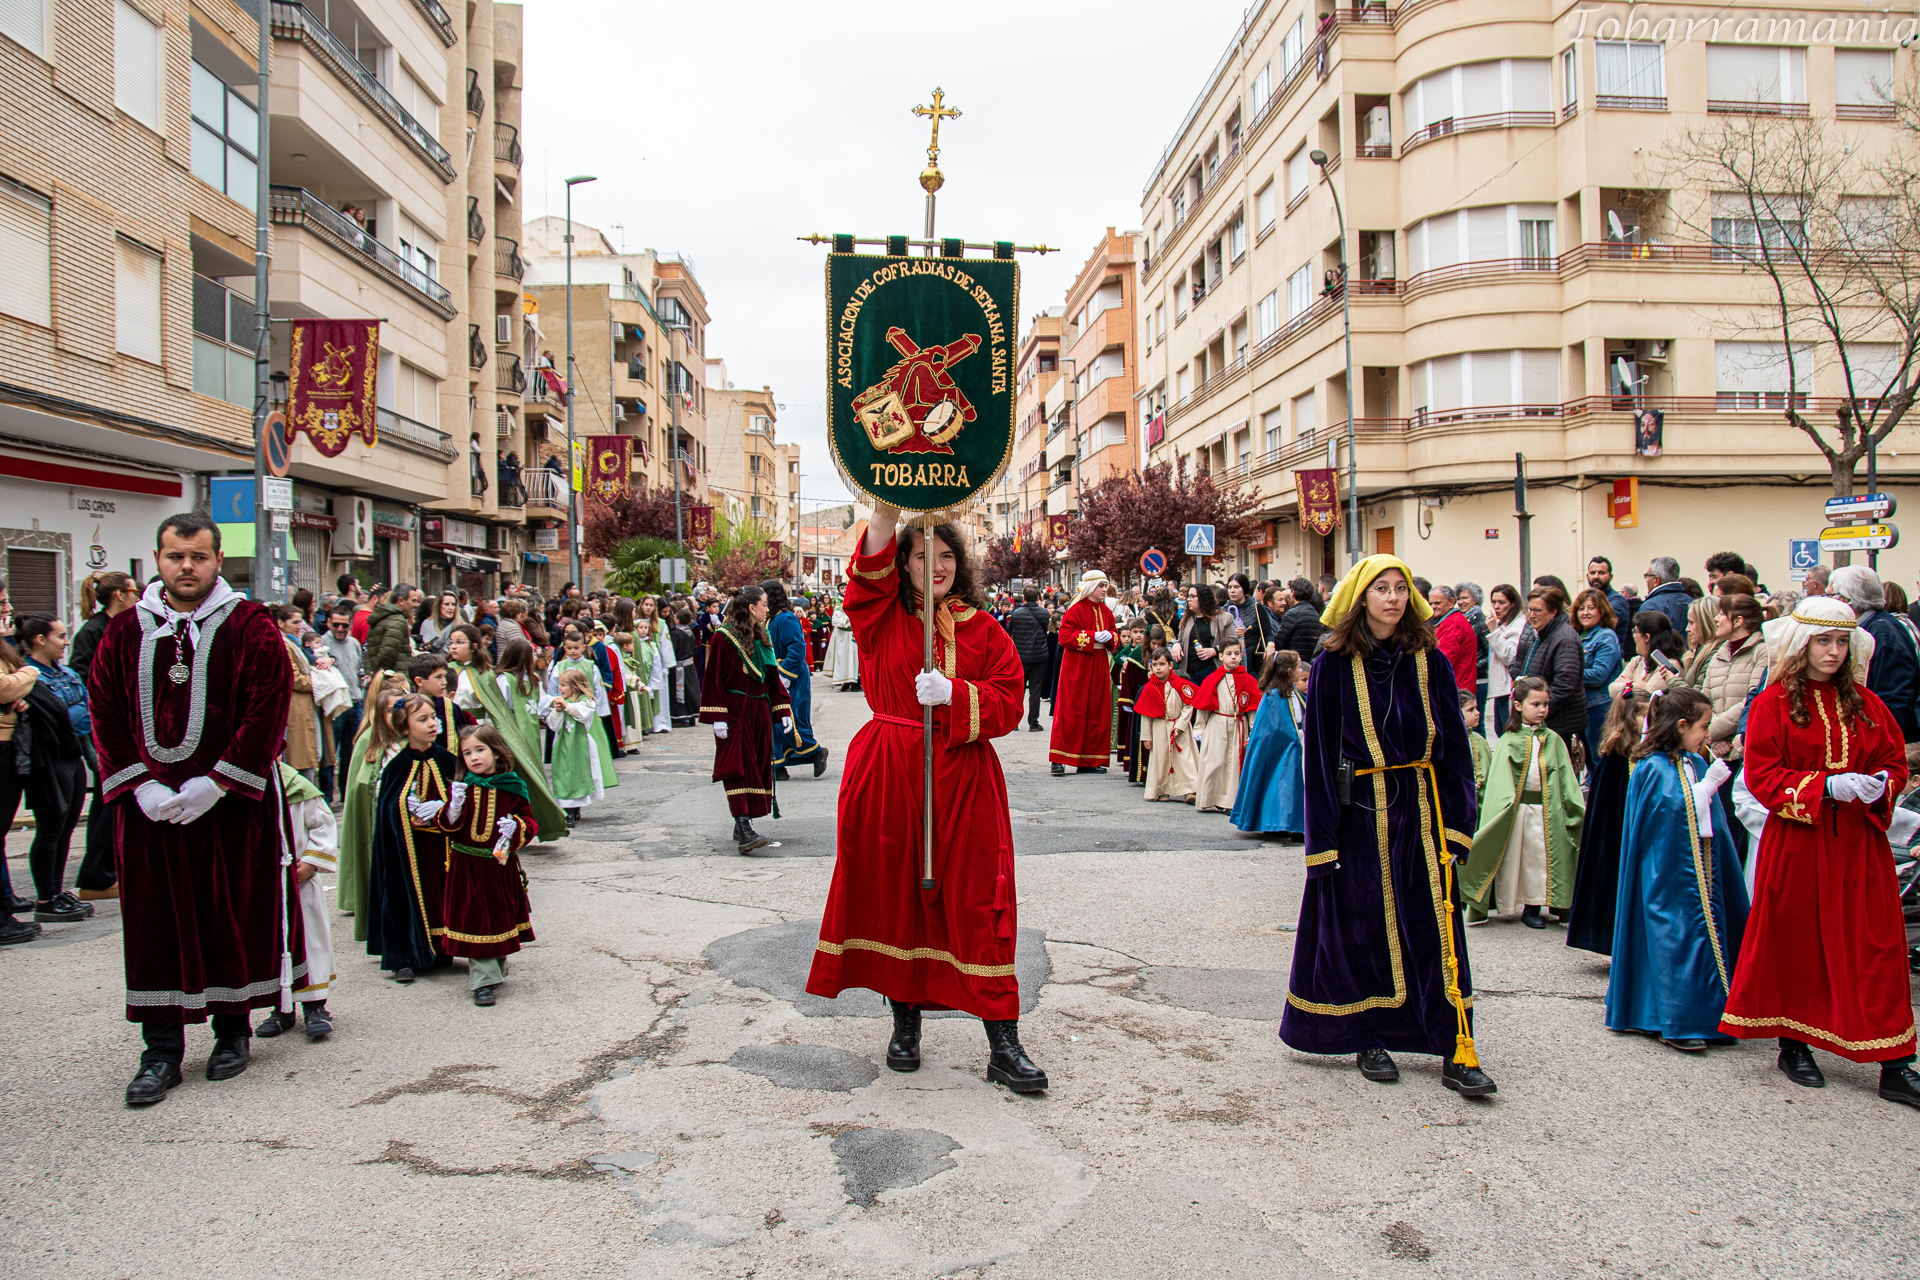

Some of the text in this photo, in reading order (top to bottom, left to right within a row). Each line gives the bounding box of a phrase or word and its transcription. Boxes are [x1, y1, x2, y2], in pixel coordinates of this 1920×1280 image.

[837, 260, 1007, 396] ASOCIACION DE COFRADIAS DE SEMANA SANTA
[870, 462, 971, 488] TOBARRA
[78, 498, 115, 513] LOS CAÑOS
